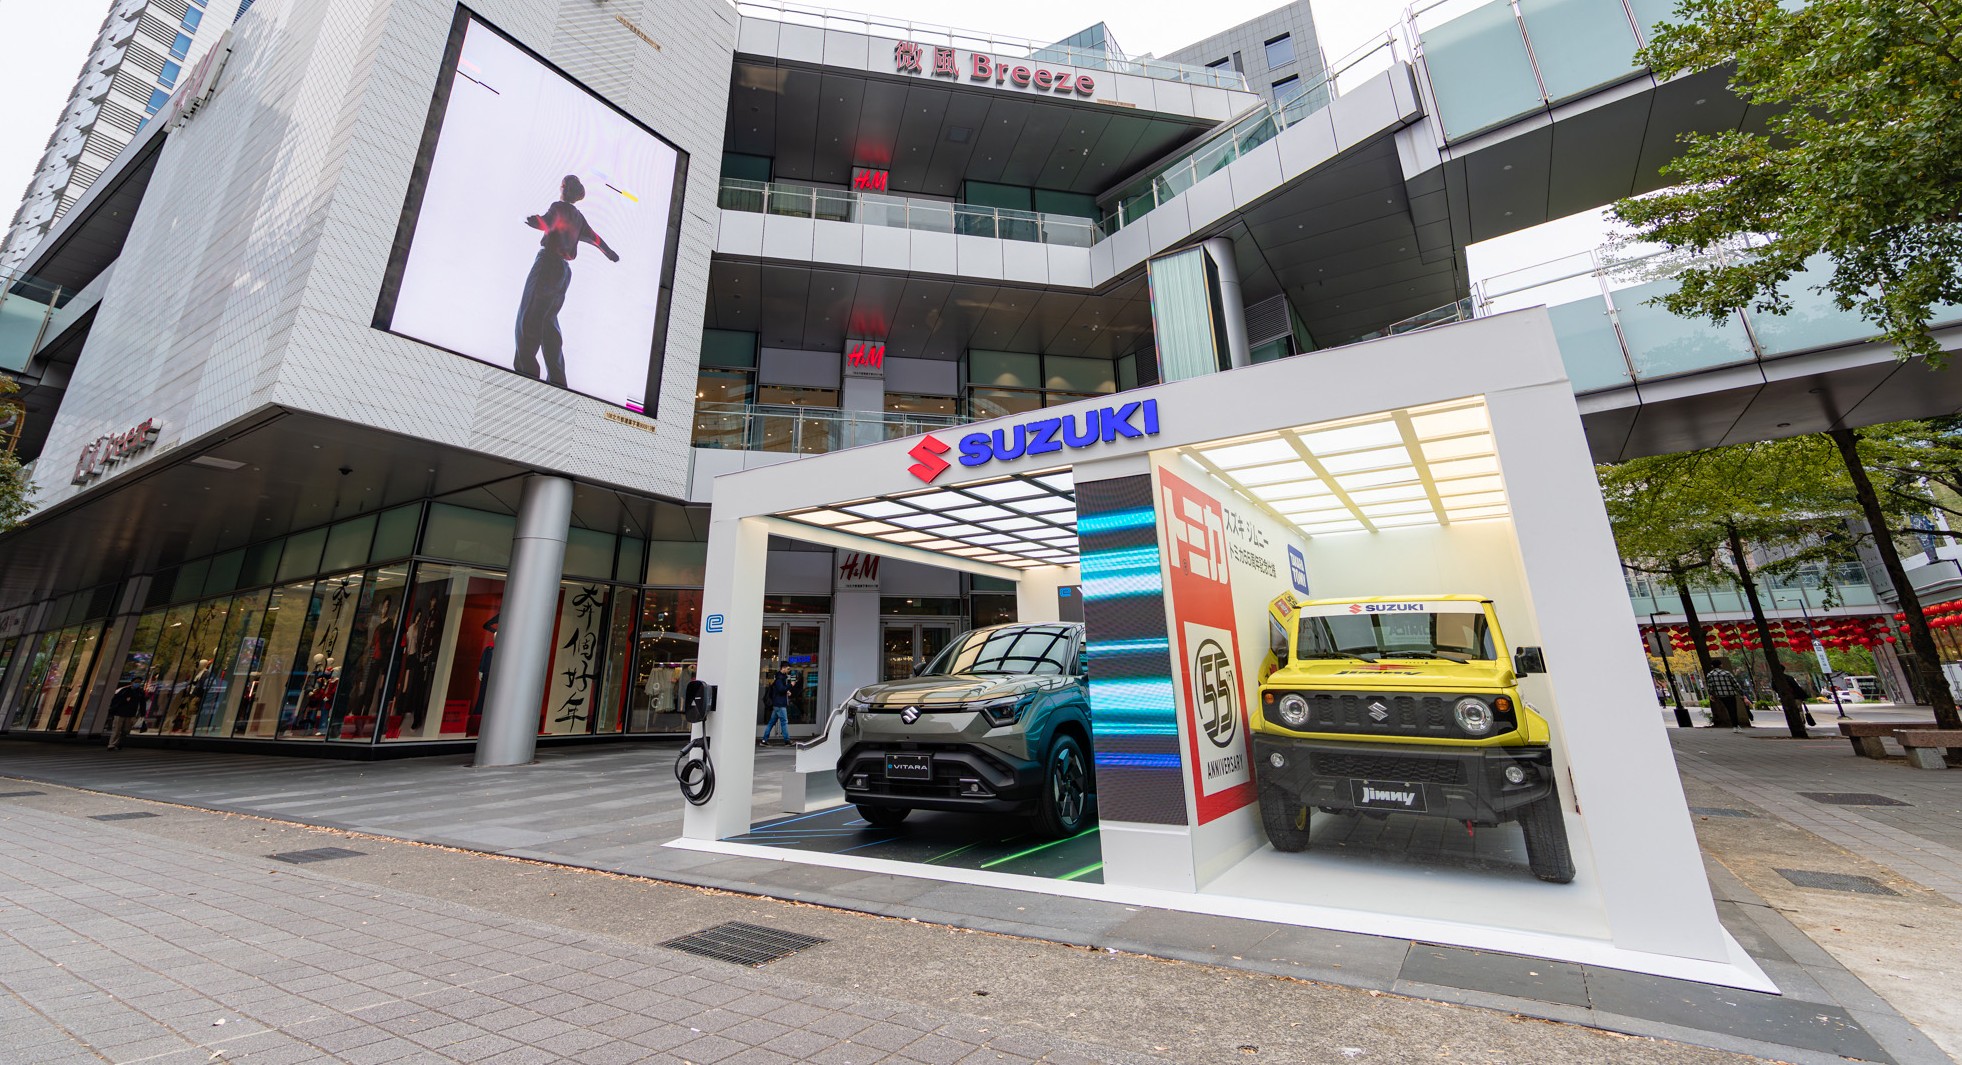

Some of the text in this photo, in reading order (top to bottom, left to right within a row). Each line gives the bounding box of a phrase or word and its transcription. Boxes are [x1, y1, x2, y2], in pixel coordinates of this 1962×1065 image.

[894, 40, 1095, 96] 微風 Breeze
[847, 344, 886, 369] H&M
[958, 398, 1160, 467] SUZUKI
[1224, 508, 1245, 540] スズキ
[840, 552, 880, 581] H&M
[1365, 603, 1424, 612] SUZUKI
[1207, 753, 1244, 780] ANNIVERSARY
